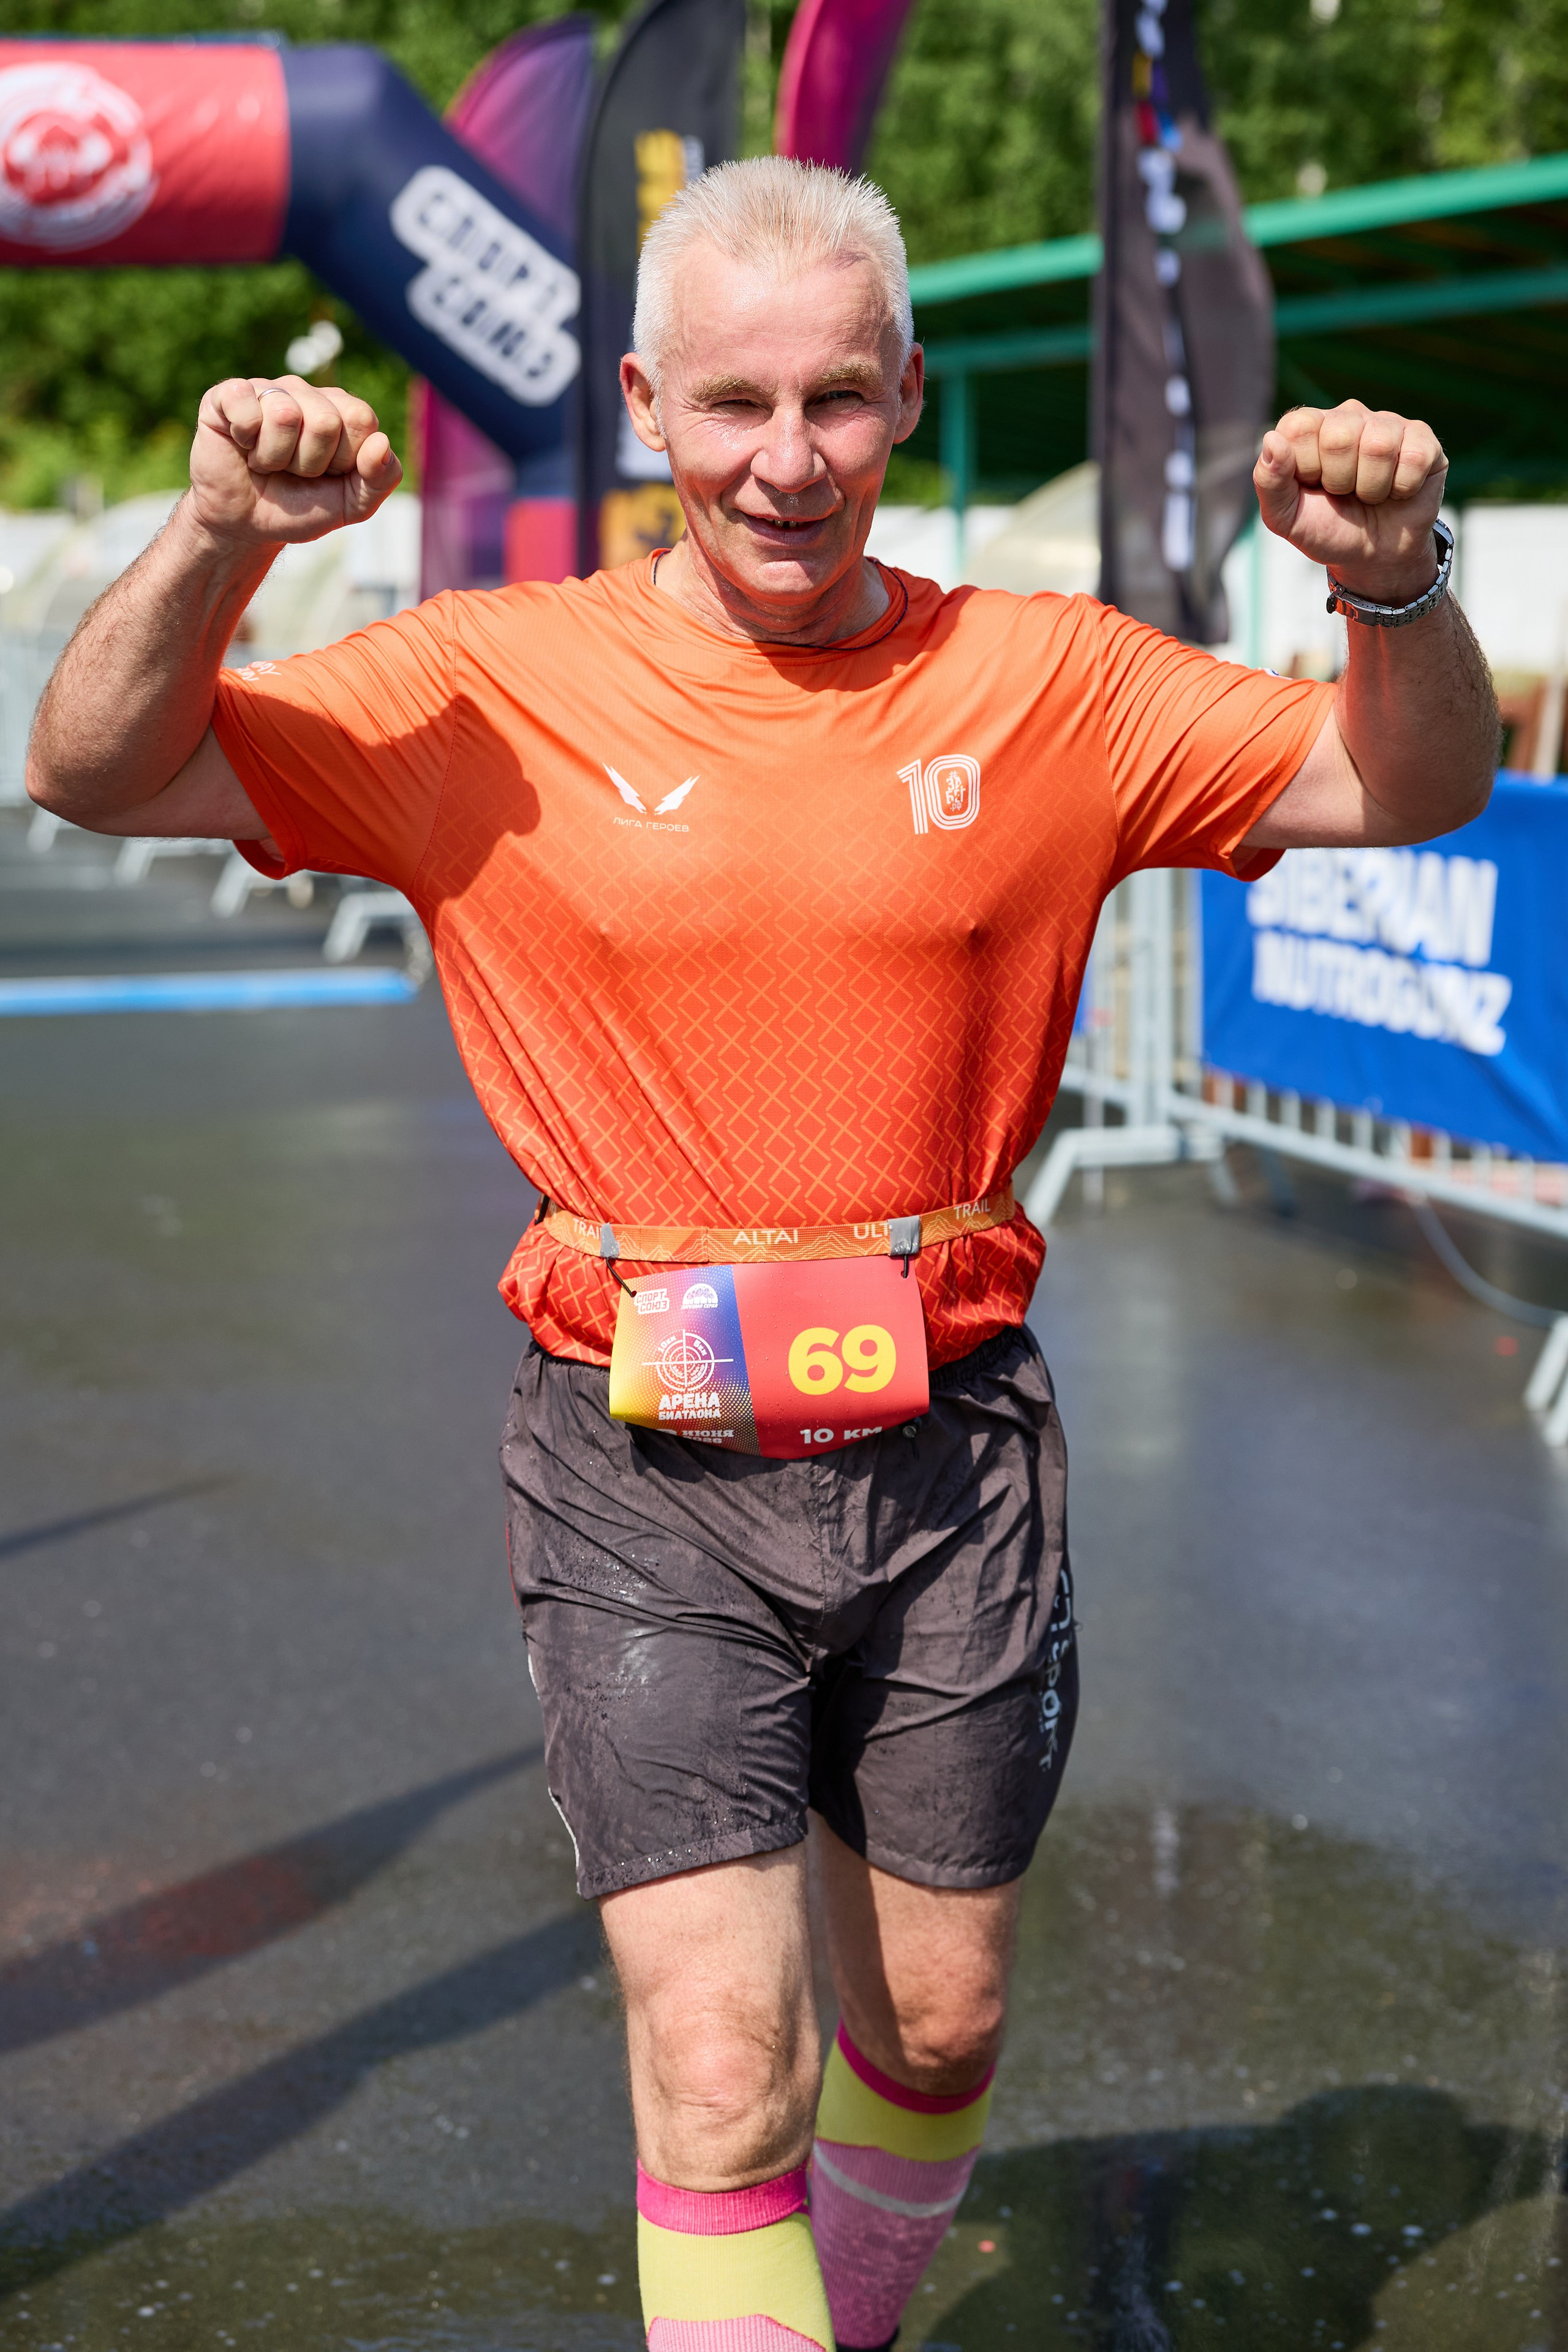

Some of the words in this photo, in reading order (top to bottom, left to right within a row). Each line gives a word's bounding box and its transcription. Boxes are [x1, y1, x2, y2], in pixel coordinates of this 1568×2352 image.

[896, 753, 981, 835] 10
[612, 817, 643, 828] ЛИГА
[646, 821, 690, 832] ГЕРОЕВ
[573, 1218, 602, 1240] TRAI
[733, 1229, 798, 1246] ALTAI
[954, 1197, 991, 1220] TRAIL
[636, 1291, 665, 1304] СПОРТ
[639, 1300, 668, 1313] СОЮЗ
[788, 1324, 896, 1395] 69
[658, 1392, 720, 1411] АРЕНА
[658, 1408, 722, 1420] БИАТЛОНА
[800, 1428, 834, 1444] 10
